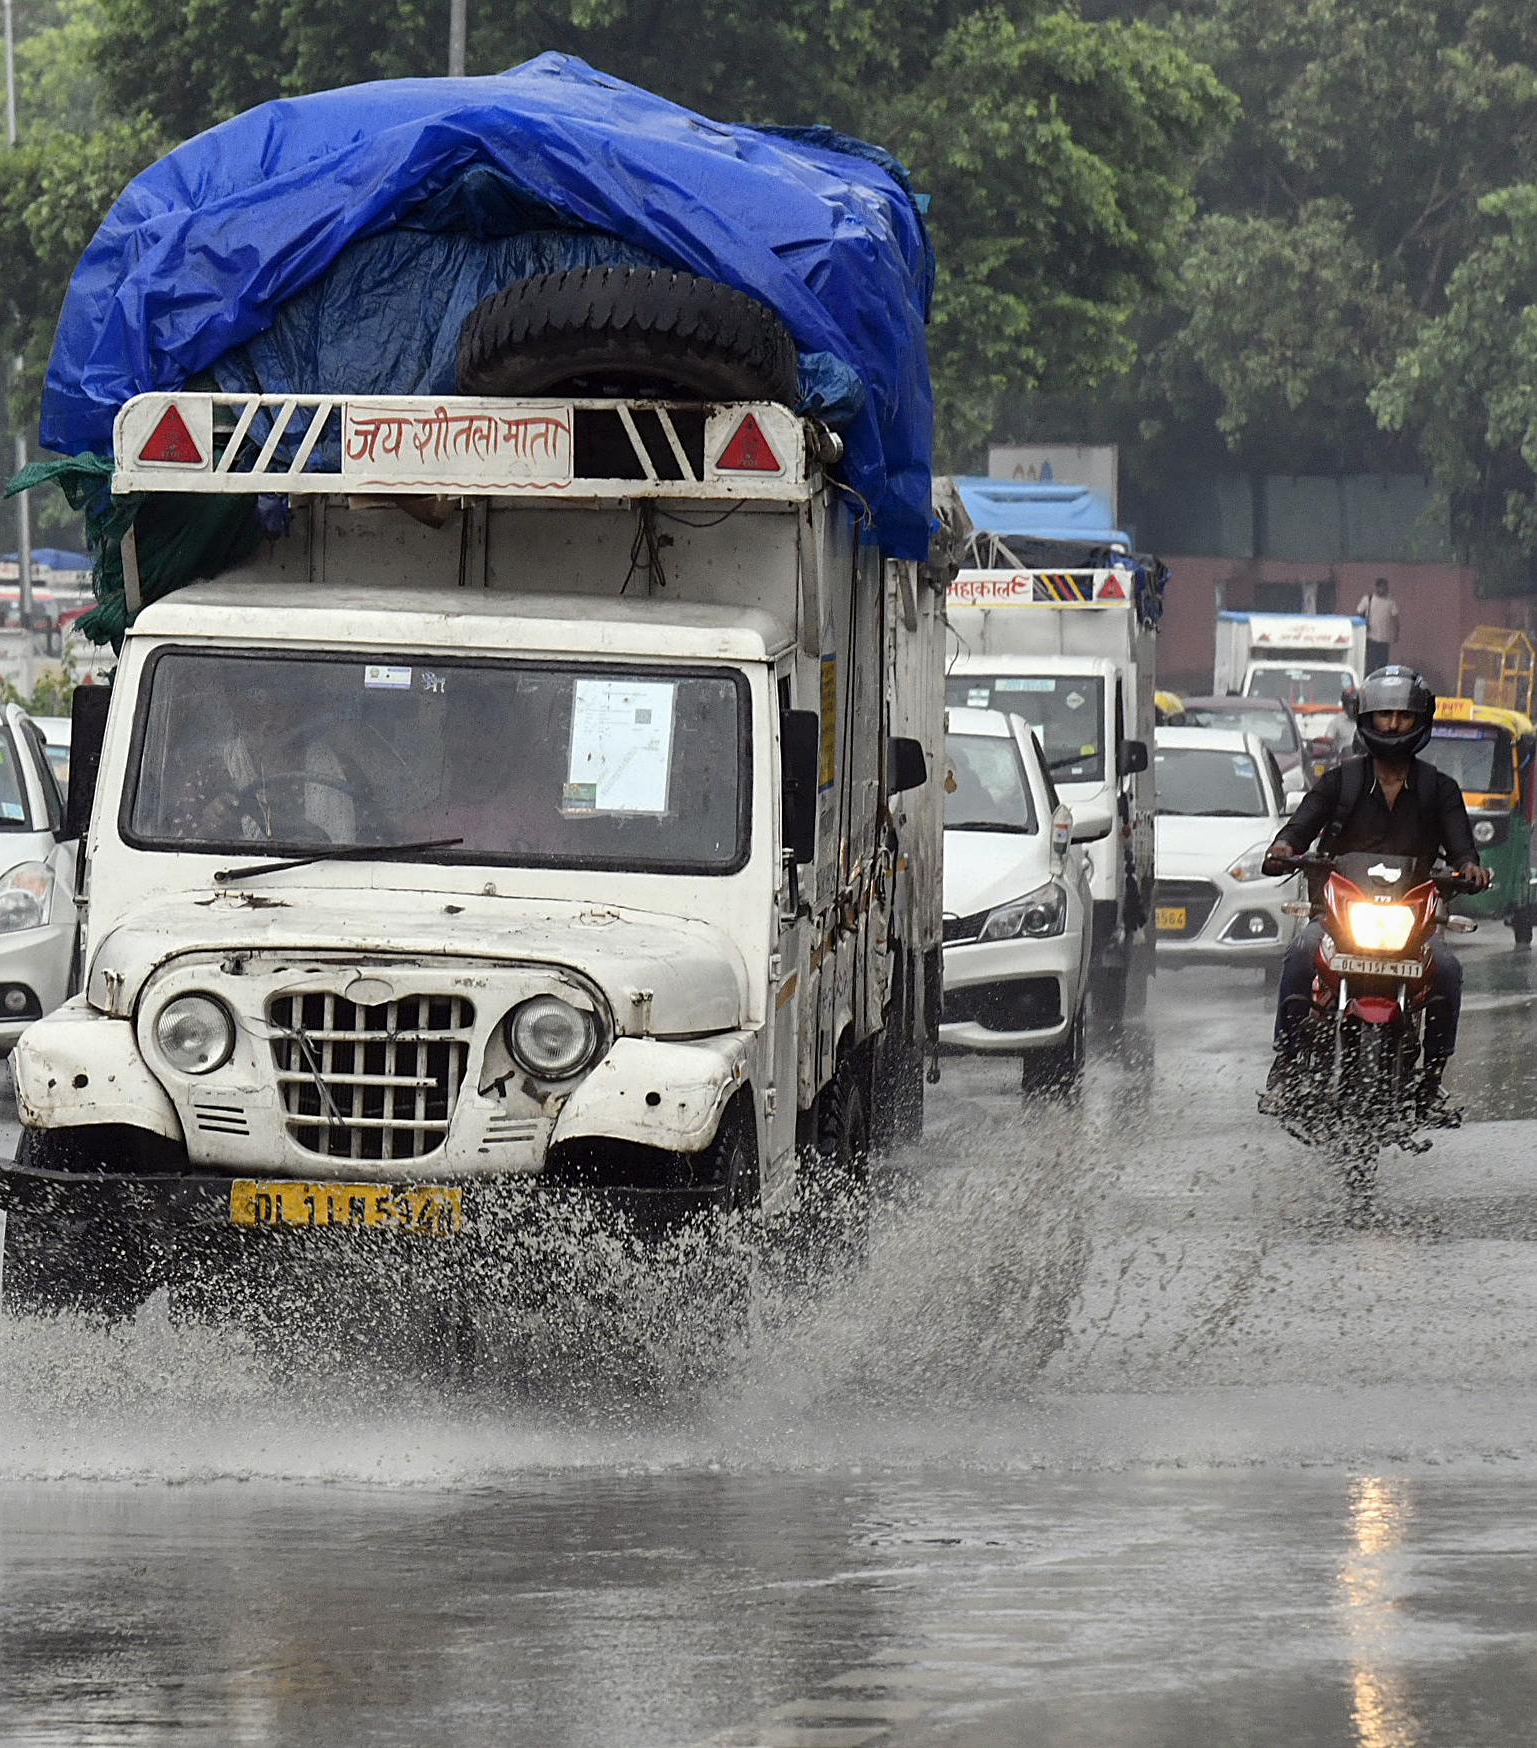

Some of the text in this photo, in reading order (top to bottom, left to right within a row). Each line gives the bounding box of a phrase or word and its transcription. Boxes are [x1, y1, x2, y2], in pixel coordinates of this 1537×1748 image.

[346, 405, 570, 464] जय शीतला माता
[1374, 895, 1392, 903] TVS
